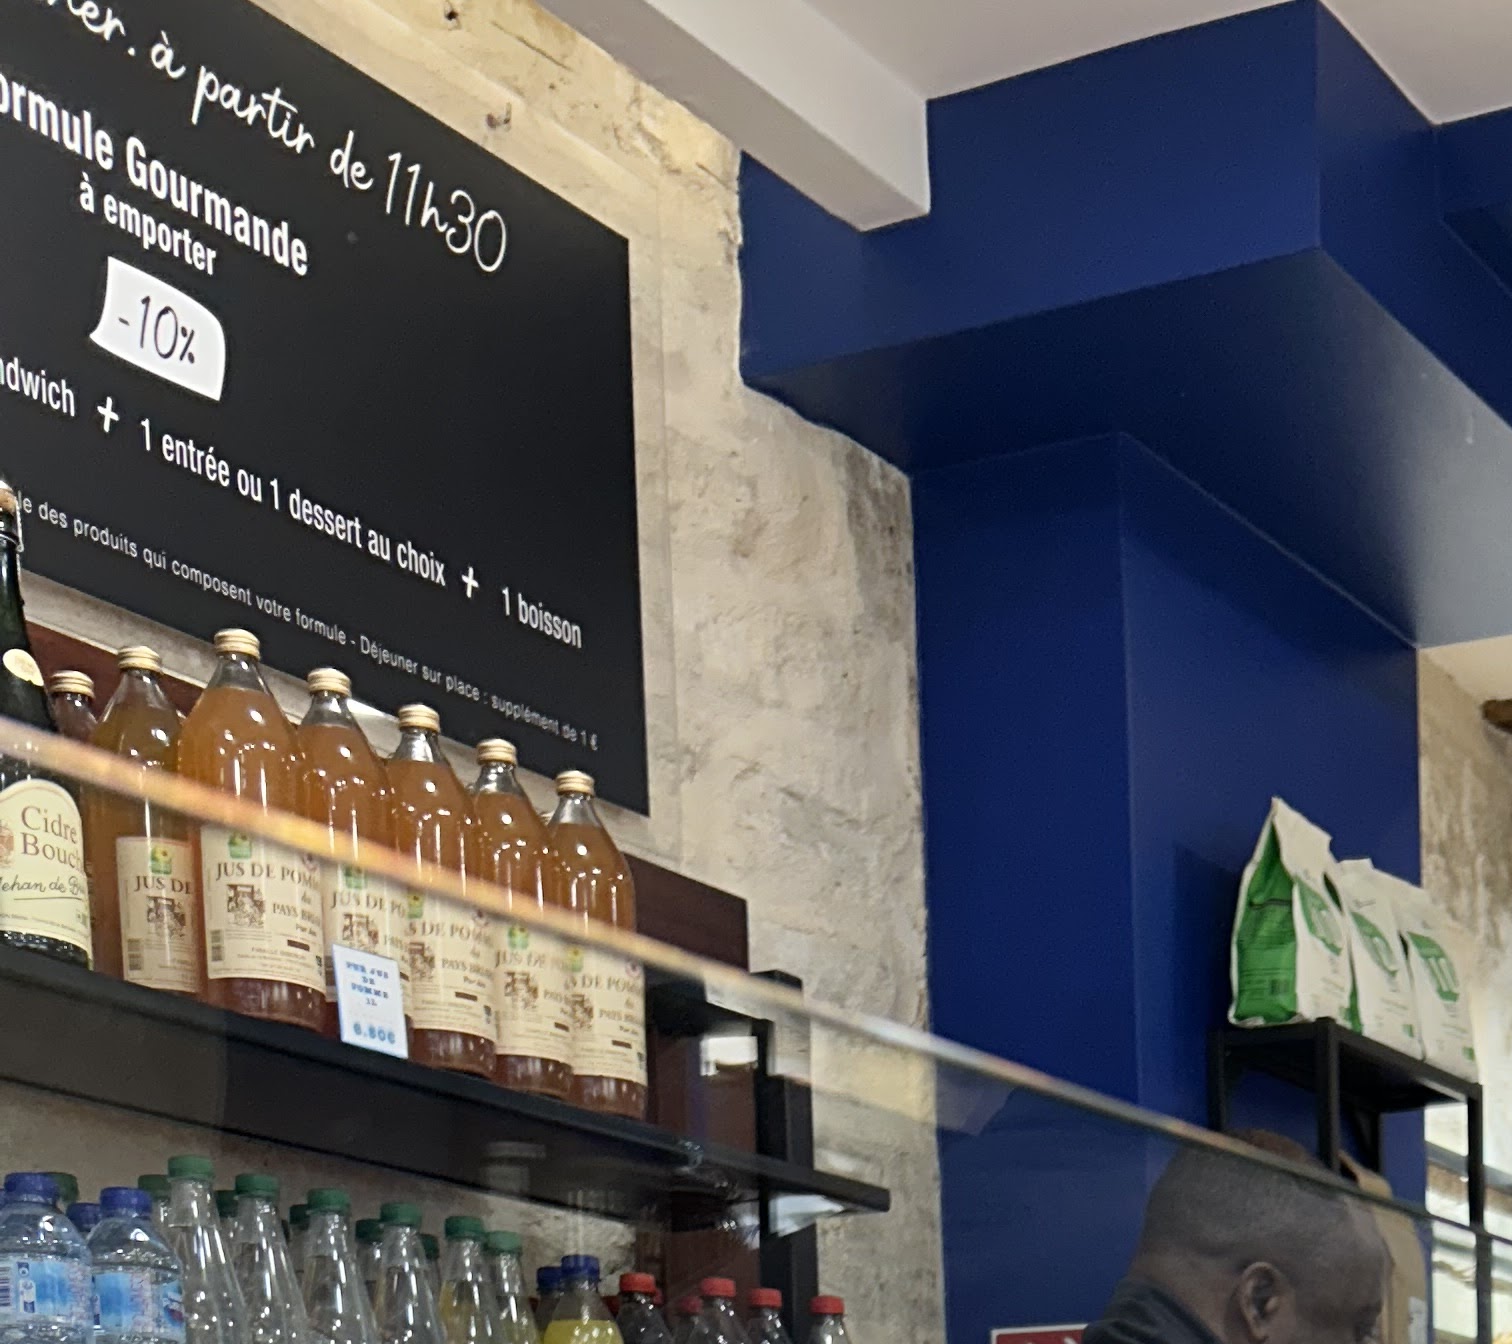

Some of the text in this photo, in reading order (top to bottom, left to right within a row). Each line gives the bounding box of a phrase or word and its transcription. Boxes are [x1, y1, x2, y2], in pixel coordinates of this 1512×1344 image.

[151, 30, 186, 79] à
[191, 65, 315, 154] partir
[330, 130, 374, 190] de
[385, 151, 507, 273] 11h30
[79, 171, 217, 275] à emporter
[126, 136, 309, 277] Gourmande
[118, 295, 196, 364] -10%
[140, 417, 152, 452] 1
[161, 446, 230, 488] entrée
[237, 468, 262, 503] ou
[269, 478, 280, 511] 1
[289, 488, 362, 549] dessert
[367, 528, 391, 562] au
[397, 541, 446, 587] choix
[501, 586, 511, 617] 1
[518, 592, 582, 649] boisson
[38, 501, 68, 529] des
[73, 517, 138, 558] produits
[143, 547, 167, 571] qui
[172, 560, 253, 606] composent
[256, 594, 292, 622] votre
[295, 607, 347, 645] formule
[360, 635, 418, 675] Déjeuner
[422, 664, 442, 686] sur
[445, 674, 481, 701] place
[491, 694, 560, 736] supplément
[21, 805, 77, 845] Cidre
[215, 862, 246, 881] JUS
[251, 862, 276, 879] DE
[134, 875, 166, 892] JUS
